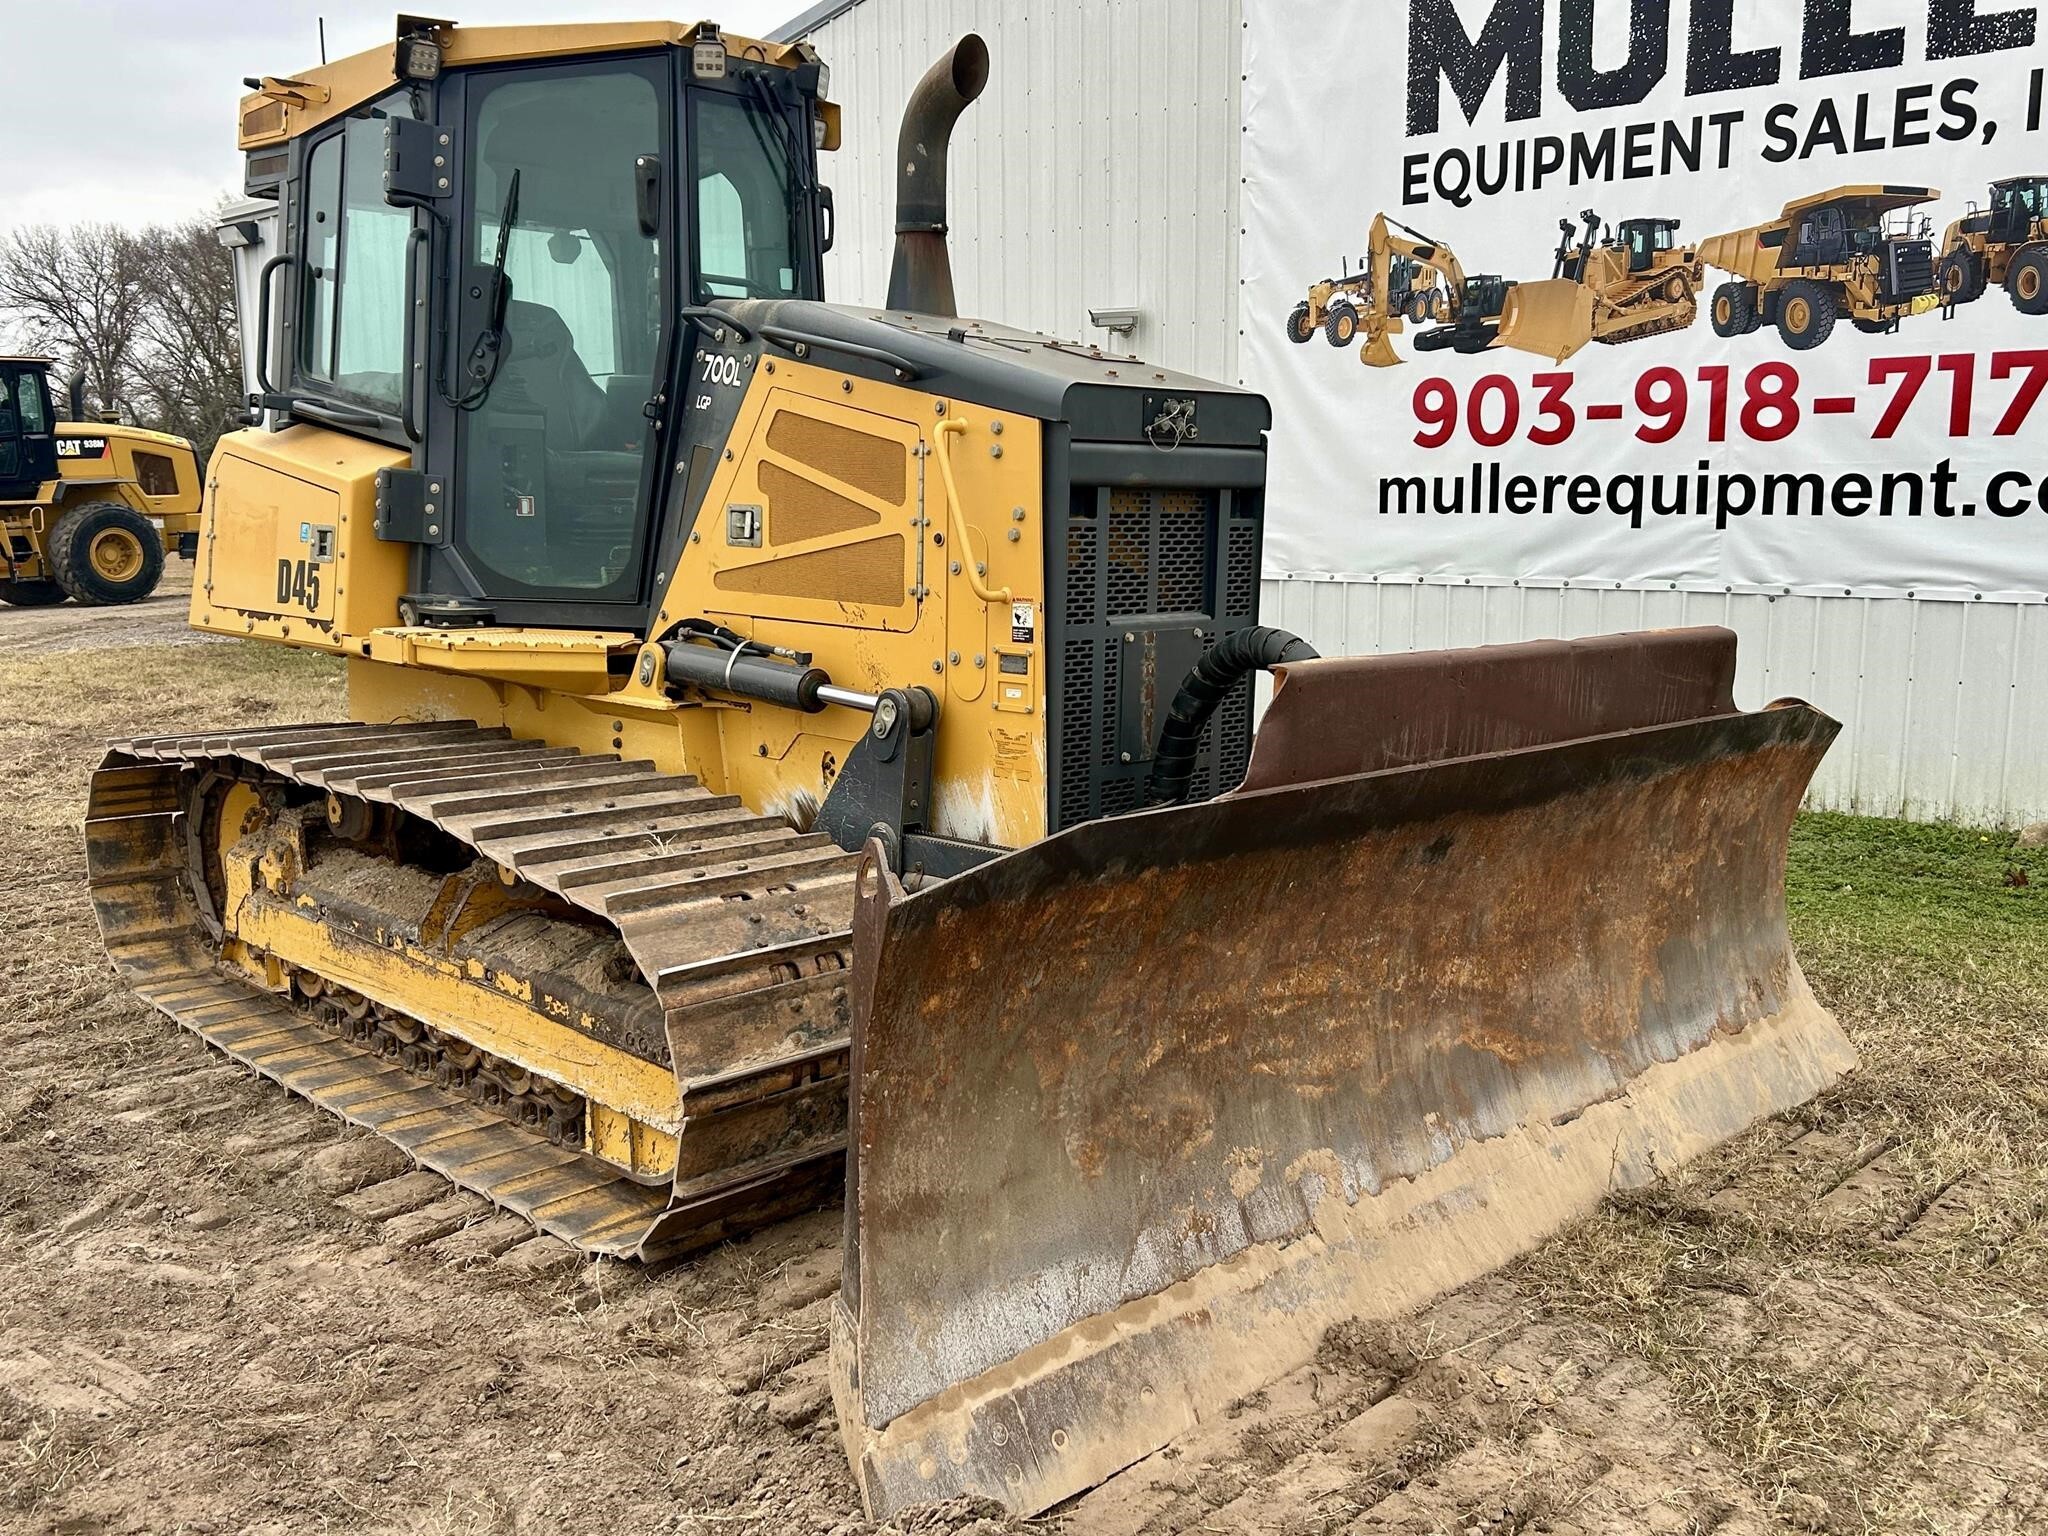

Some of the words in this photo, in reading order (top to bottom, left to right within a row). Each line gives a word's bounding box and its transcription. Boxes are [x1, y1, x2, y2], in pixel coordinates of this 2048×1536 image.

[1402, 110, 1745, 208] EQUIPMENT
[1760, 78, 1998, 163] SALES,
[702, 354, 741, 387] 700L
[695, 394, 712, 410] LGP
[1412, 349, 2048, 449] 903-918-717
[56, 439, 81, 456] CAT
[1379, 457, 2048, 530] mullerequipment.c
[277, 558, 320, 613] D45
